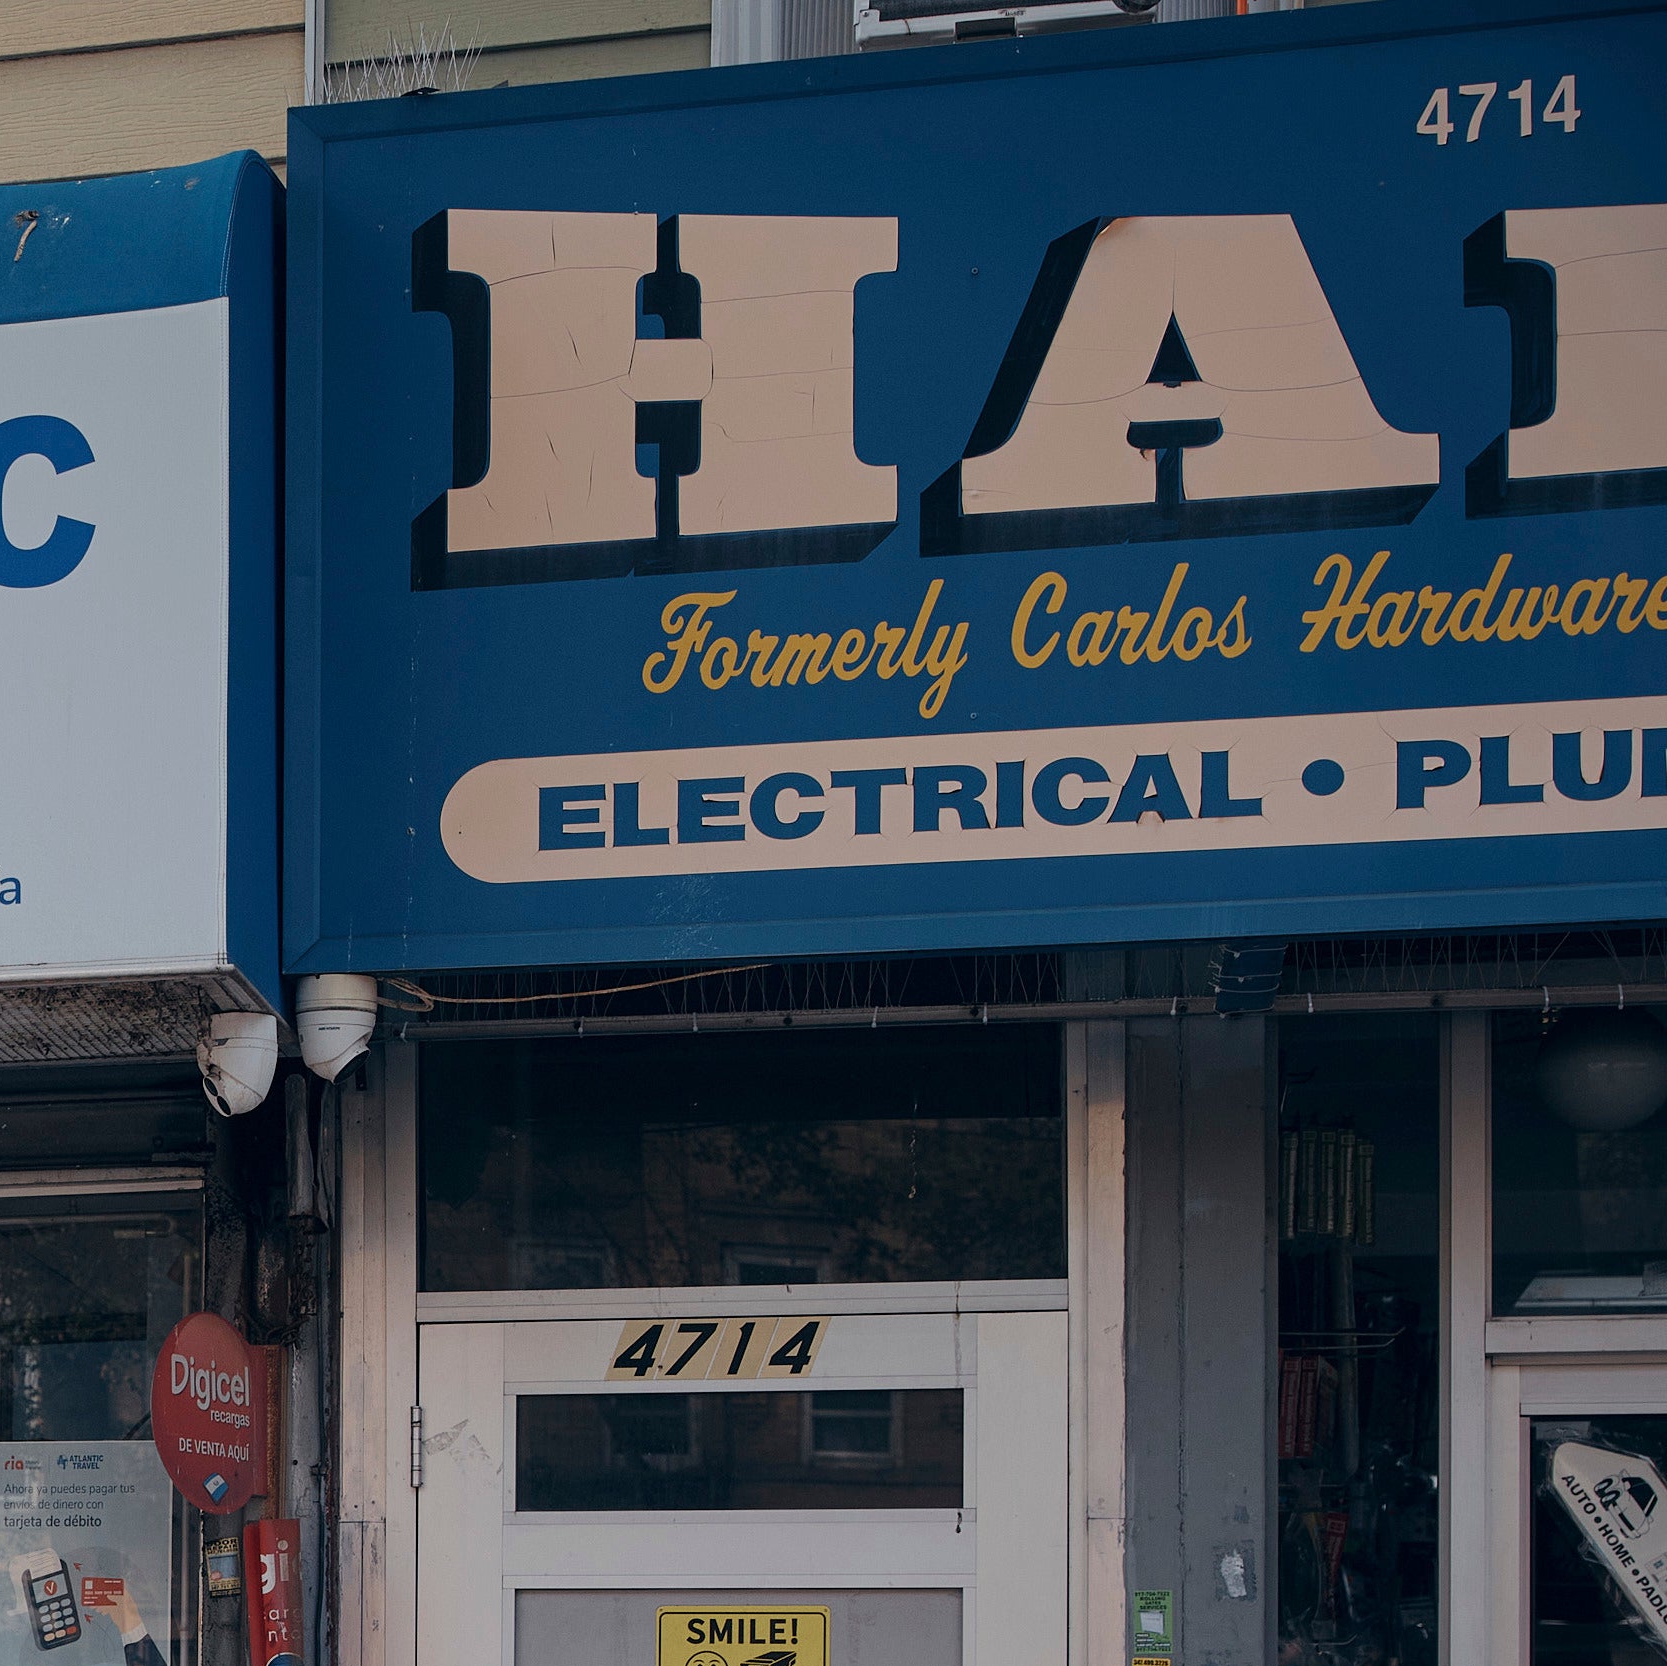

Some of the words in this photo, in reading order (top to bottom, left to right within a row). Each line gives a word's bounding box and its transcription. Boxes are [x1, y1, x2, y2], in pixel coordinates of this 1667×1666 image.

[1415, 74, 1579, 145] 4714
[642, 580, 967, 719] Formerly
[1011, 562, 1254, 669] Carlos
[537, 749, 1264, 851] ELECTRICAL
[614, 1321, 821, 1376] 4714
[171, 1353, 249, 1410] Digicel
[209, 1408, 250, 1429] recargas
[178, 1437, 193, 1453] DE
[193, 1439, 226, 1458] VENTA
[227, 1441, 250, 1462] AQUÍ
[3, 1483, 34, 1494] Ahora
[36, 1485, 48, 1496] ya
[50, 1484, 87, 1496] puedes
[88, 1484, 118, 1496] pagar
[119, 1484, 135, 1494] tus
[3, 1515, 43, 1530] tarjeta
[45, 1515, 61, 1528] de
[63, 1514, 102, 1528] débito
[687, 1619, 799, 1645] SMILE!
